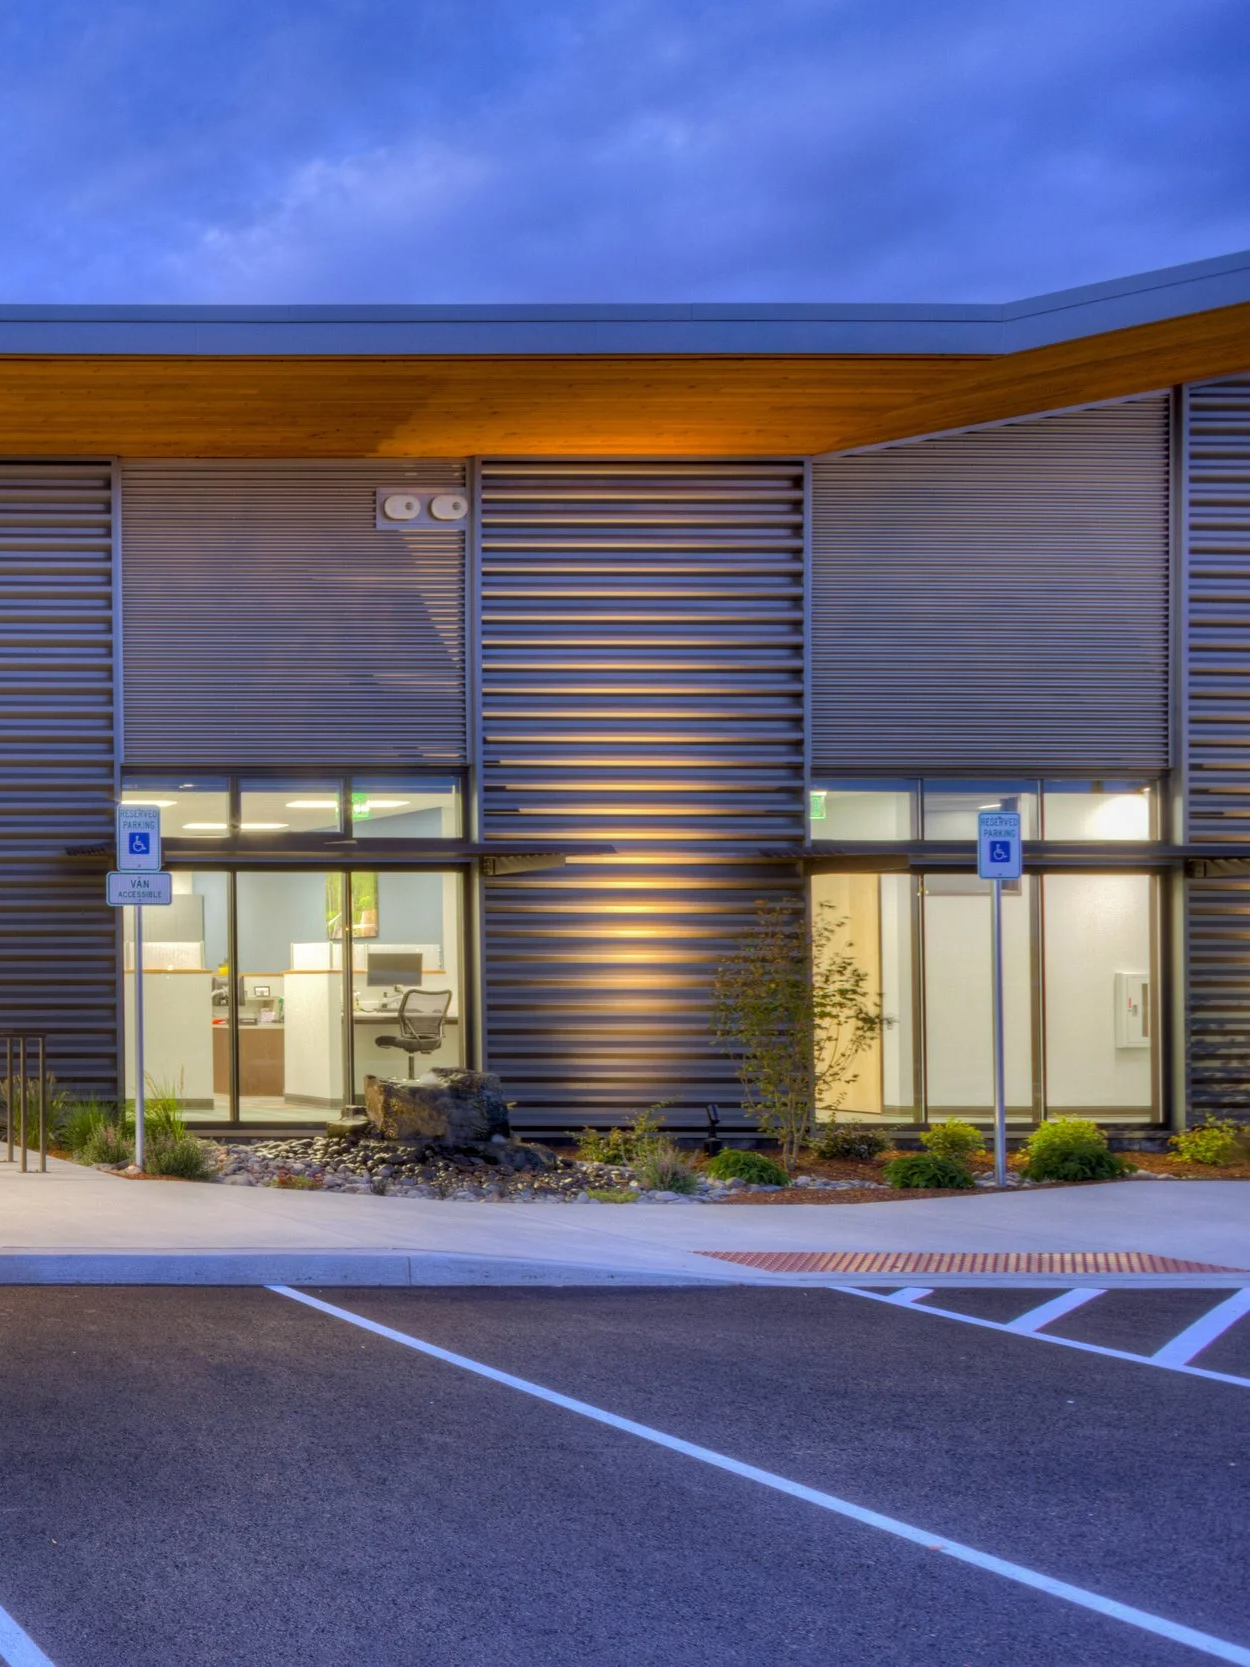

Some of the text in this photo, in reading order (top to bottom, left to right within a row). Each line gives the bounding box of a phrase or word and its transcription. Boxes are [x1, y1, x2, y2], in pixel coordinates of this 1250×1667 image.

[120, 809, 158, 818] RESERVED
[122, 821, 155, 830] PARKING
[981, 817, 1018, 827] RESERVED
[983, 829, 1016, 838] PARKING
[130, 879, 150, 889] VAN
[118, 890, 162, 898] ACCESSIBLE
